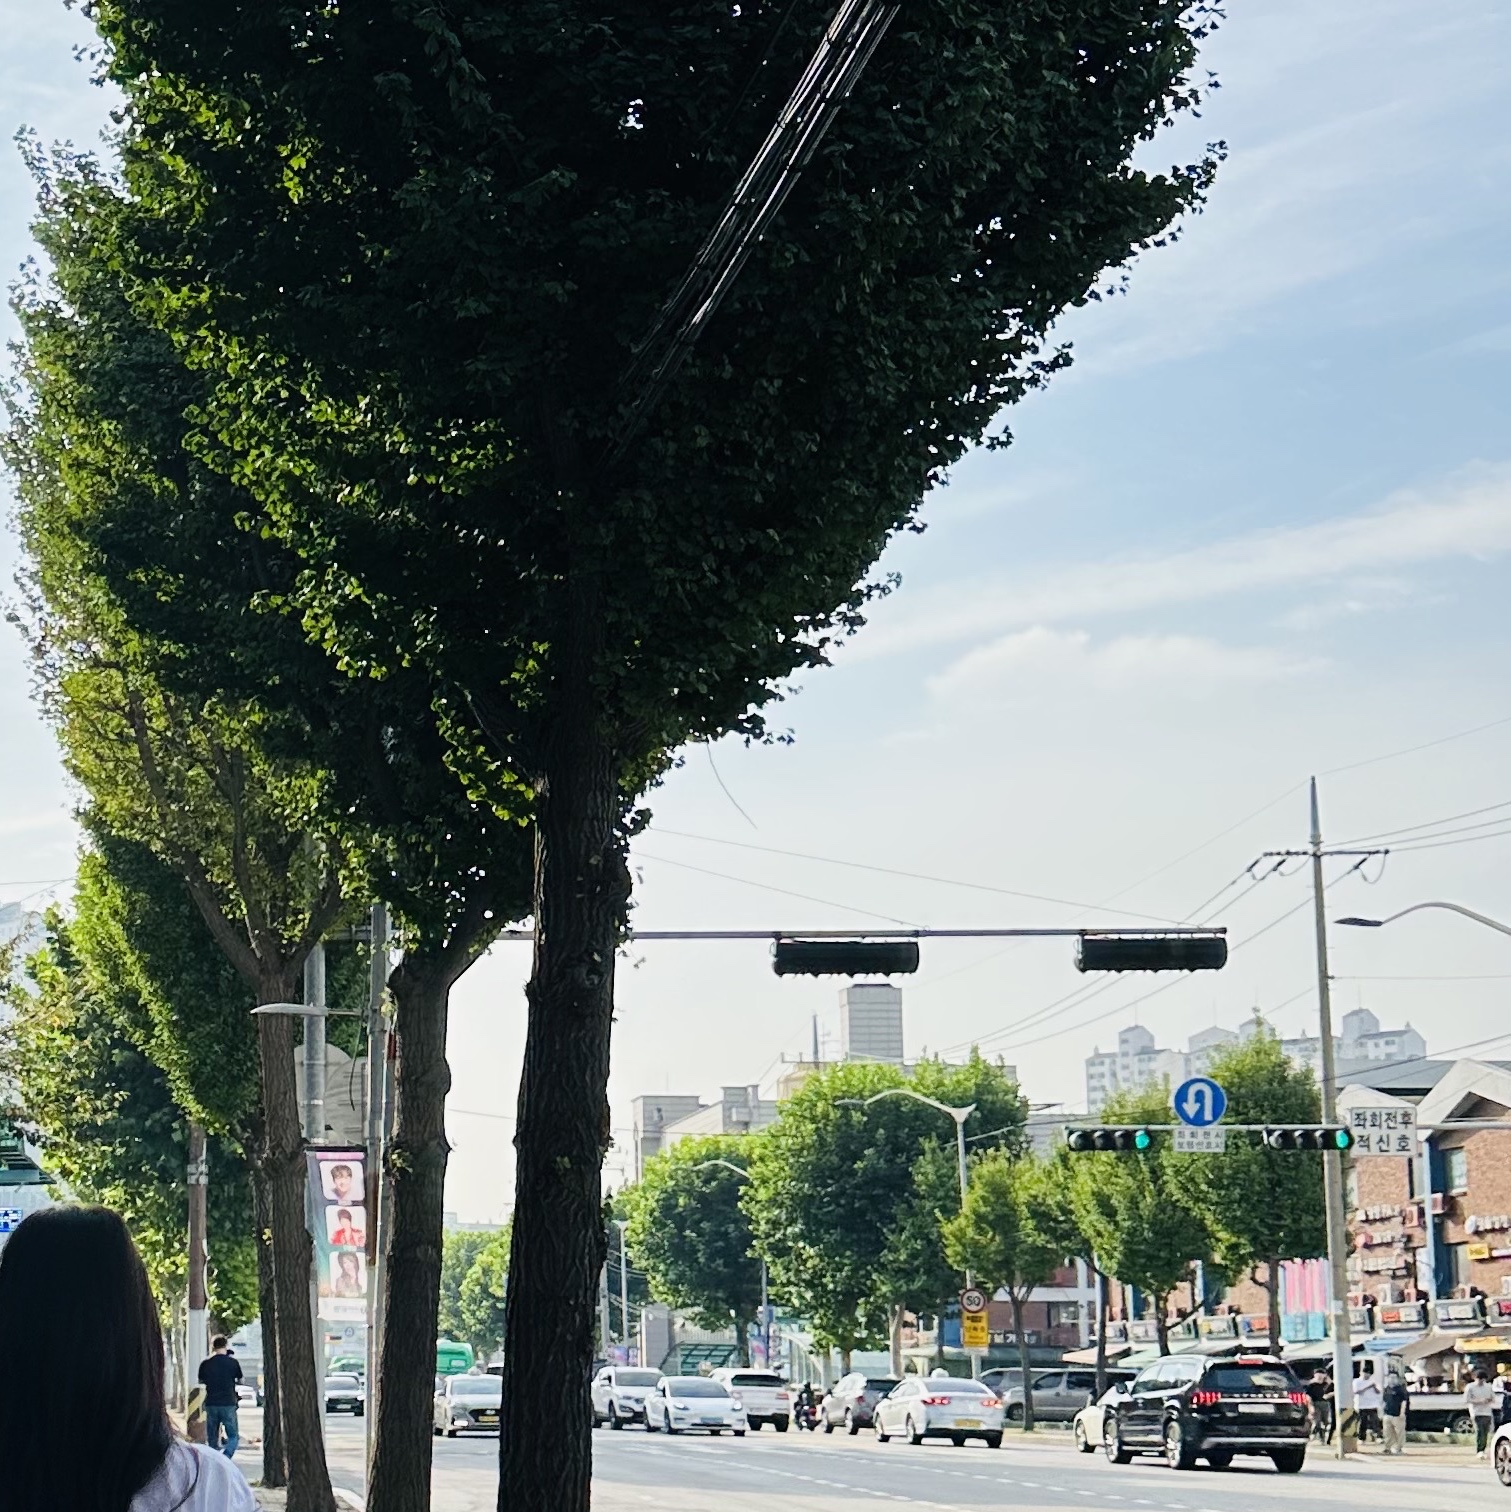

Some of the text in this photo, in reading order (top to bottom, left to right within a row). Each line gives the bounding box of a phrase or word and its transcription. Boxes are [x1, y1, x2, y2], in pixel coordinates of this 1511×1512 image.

[1354, 1109, 1414, 1133] 좌회전후
[1356, 1134, 1411, 1153] 적신호
[966, 1295, 981, 1306] 50
